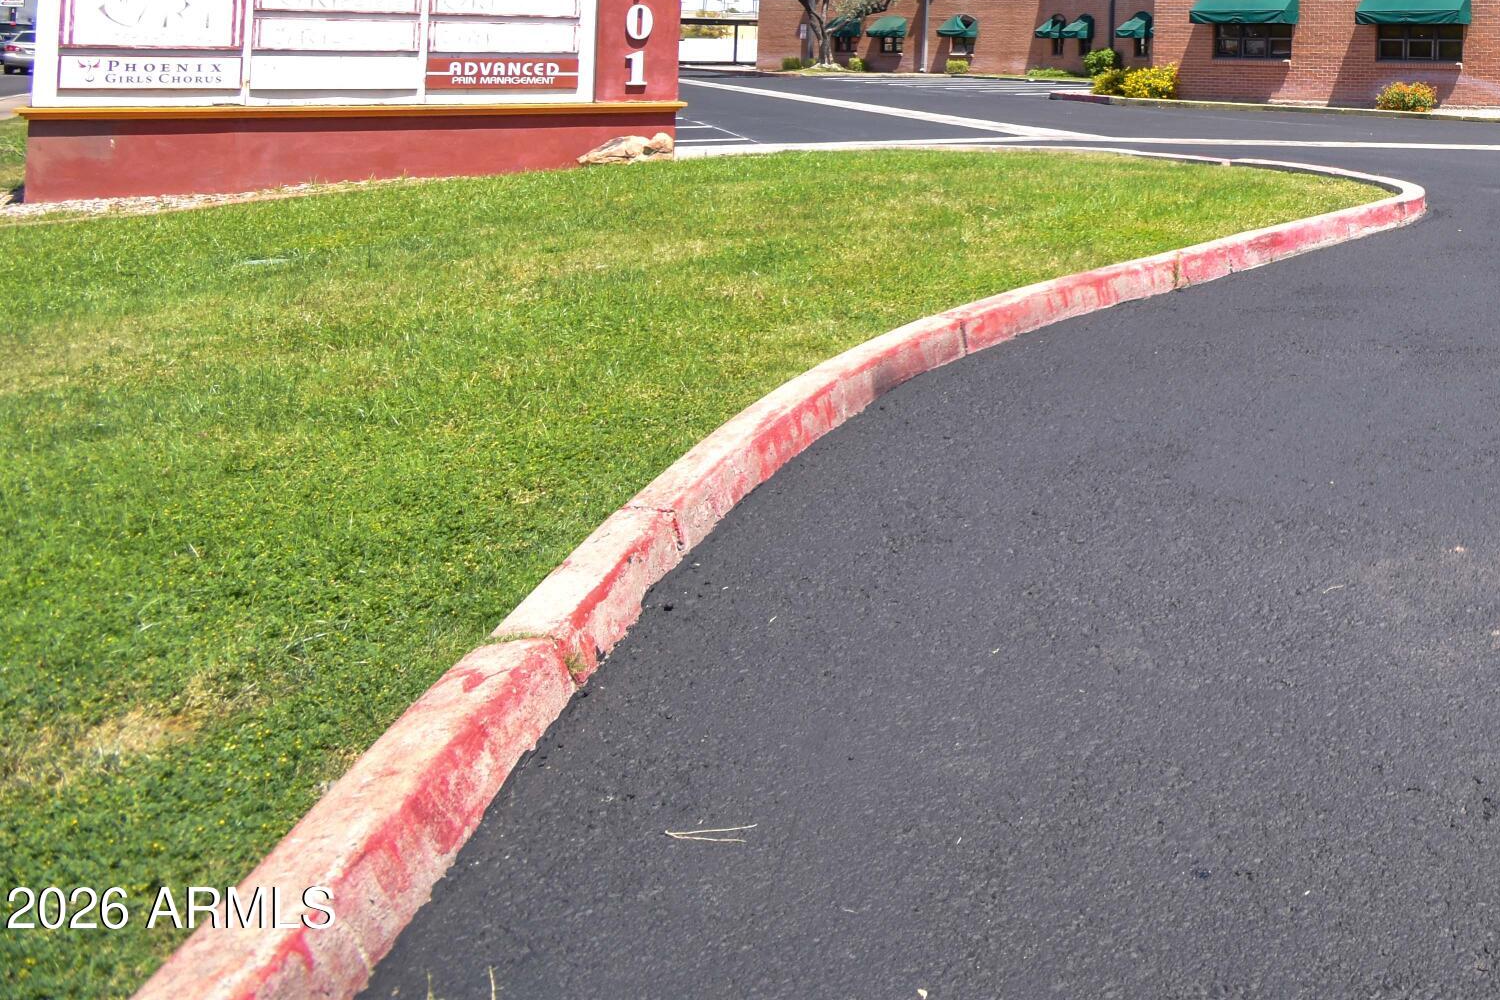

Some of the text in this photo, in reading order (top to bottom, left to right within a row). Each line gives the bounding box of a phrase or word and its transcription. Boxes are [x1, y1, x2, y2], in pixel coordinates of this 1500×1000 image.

[107, 60, 222, 73] PHOENIX
[449, 61, 560, 76] ADVANCED
[105, 73, 222, 84] GIRLS CHORUS
[451, 76, 556, 85] PAIN MANAGEMENT
